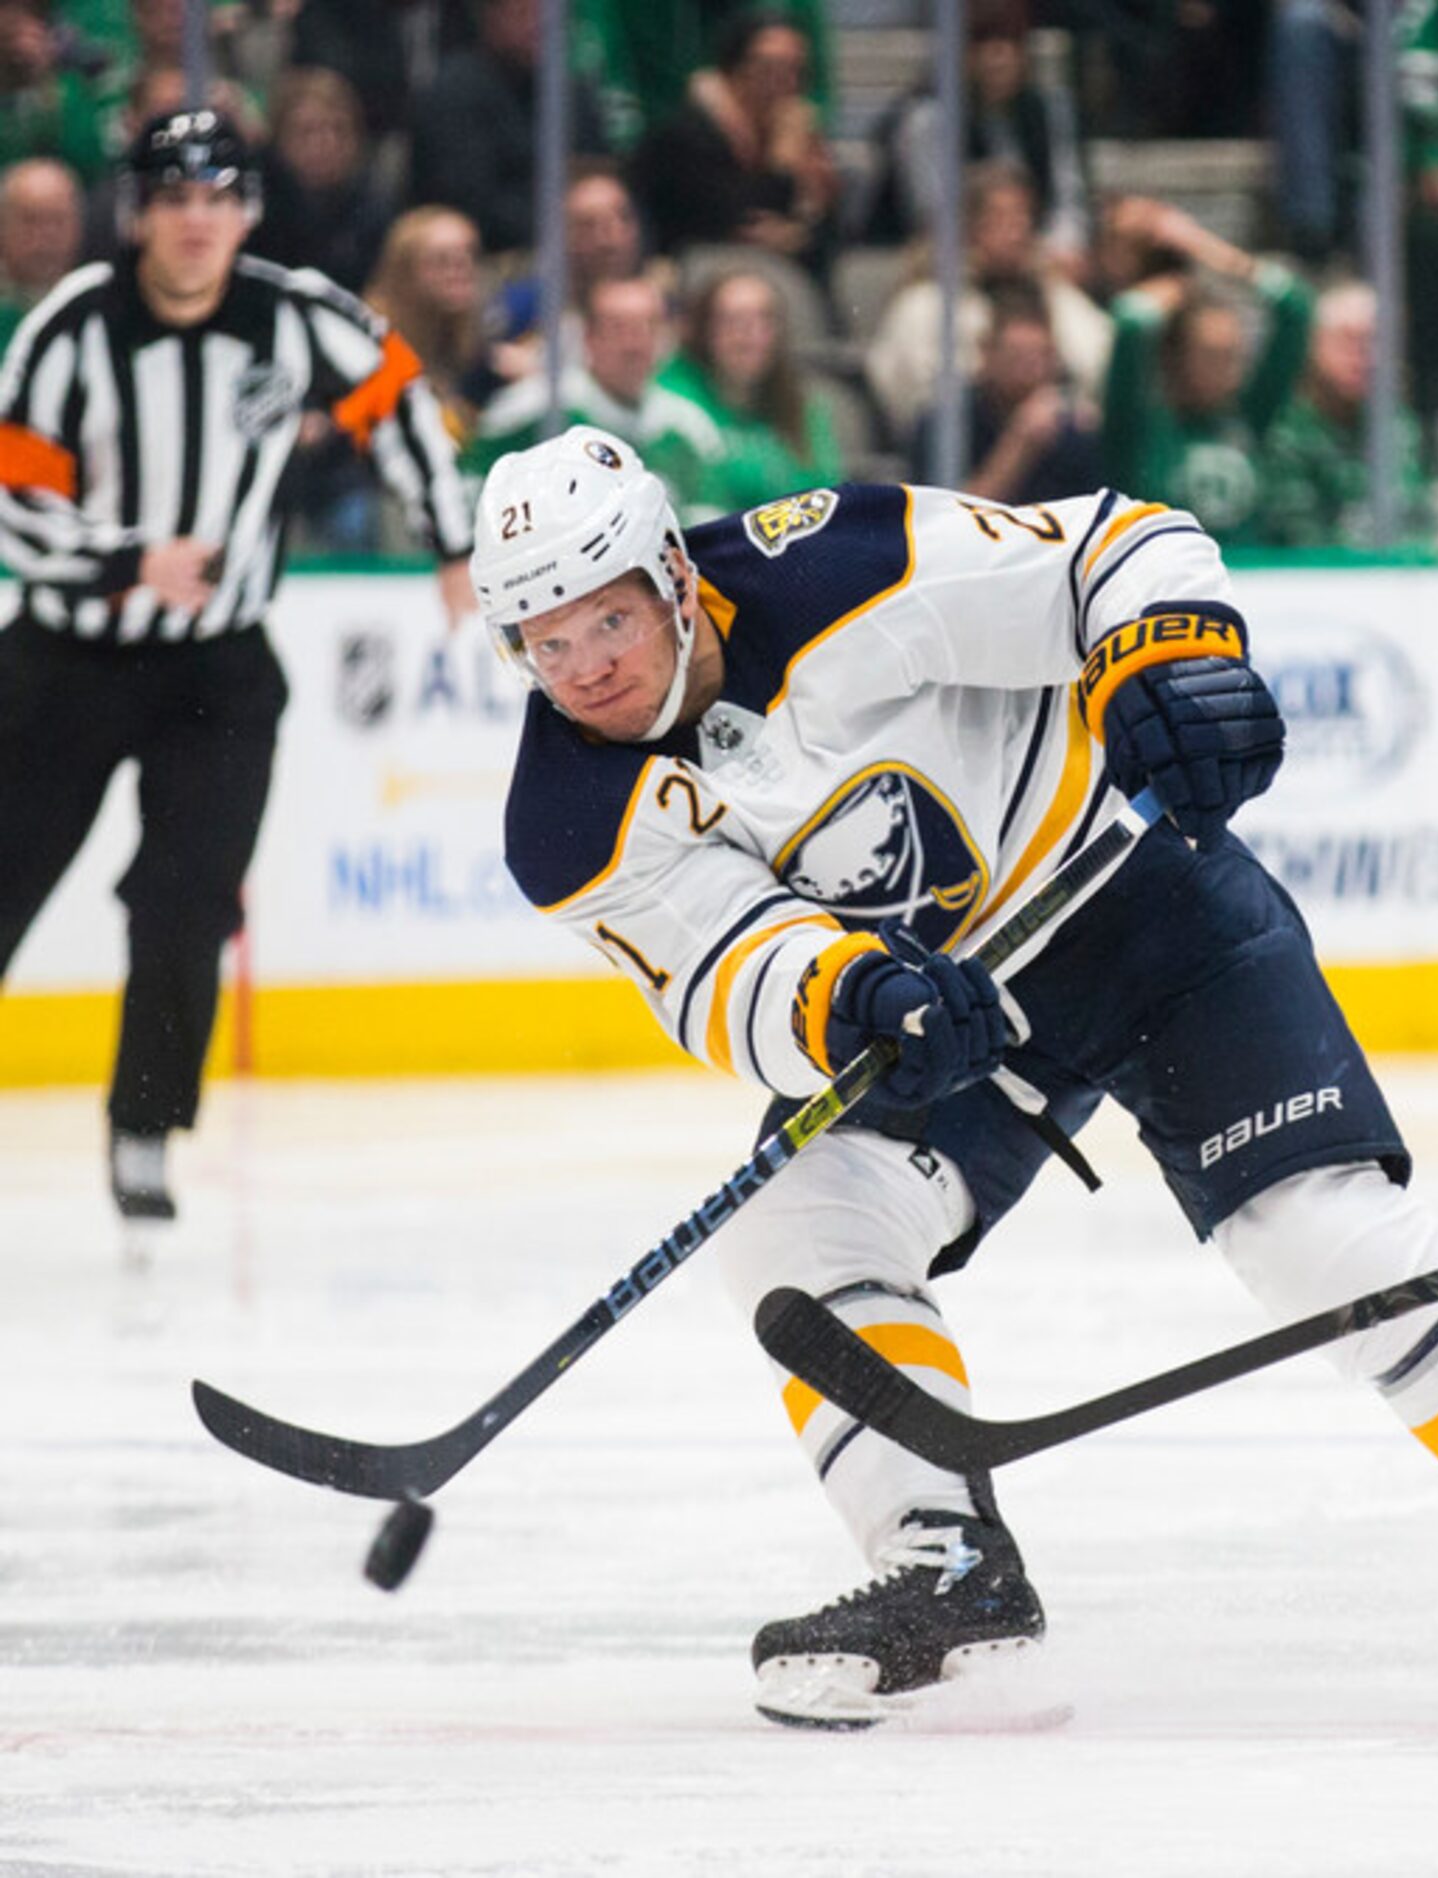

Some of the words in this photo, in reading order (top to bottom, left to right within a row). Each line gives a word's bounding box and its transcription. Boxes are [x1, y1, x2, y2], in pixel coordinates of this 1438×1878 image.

[502, 501, 532, 540] 21
[1079, 616, 1230, 714] AUER
[1200, 1087, 1343, 1168] BAUER
[605, 1160, 768, 1322] BAUER
